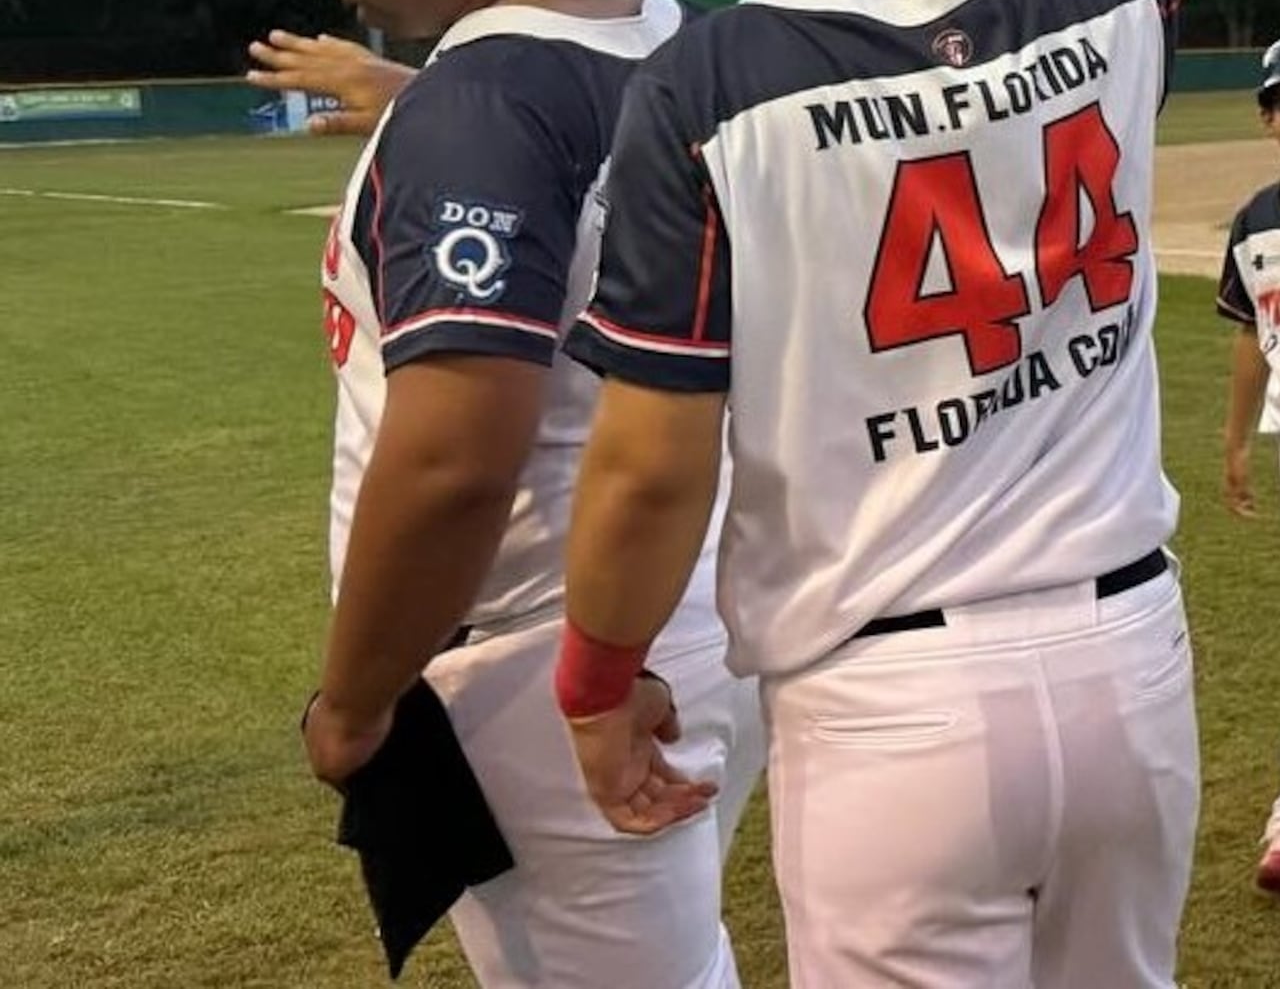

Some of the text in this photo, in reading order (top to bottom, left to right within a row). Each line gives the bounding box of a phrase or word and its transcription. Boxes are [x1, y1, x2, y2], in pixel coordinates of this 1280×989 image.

[439, 201, 518, 233] DON
[864, 101, 1139, 377] 44
[432, 226, 504, 297] Q
